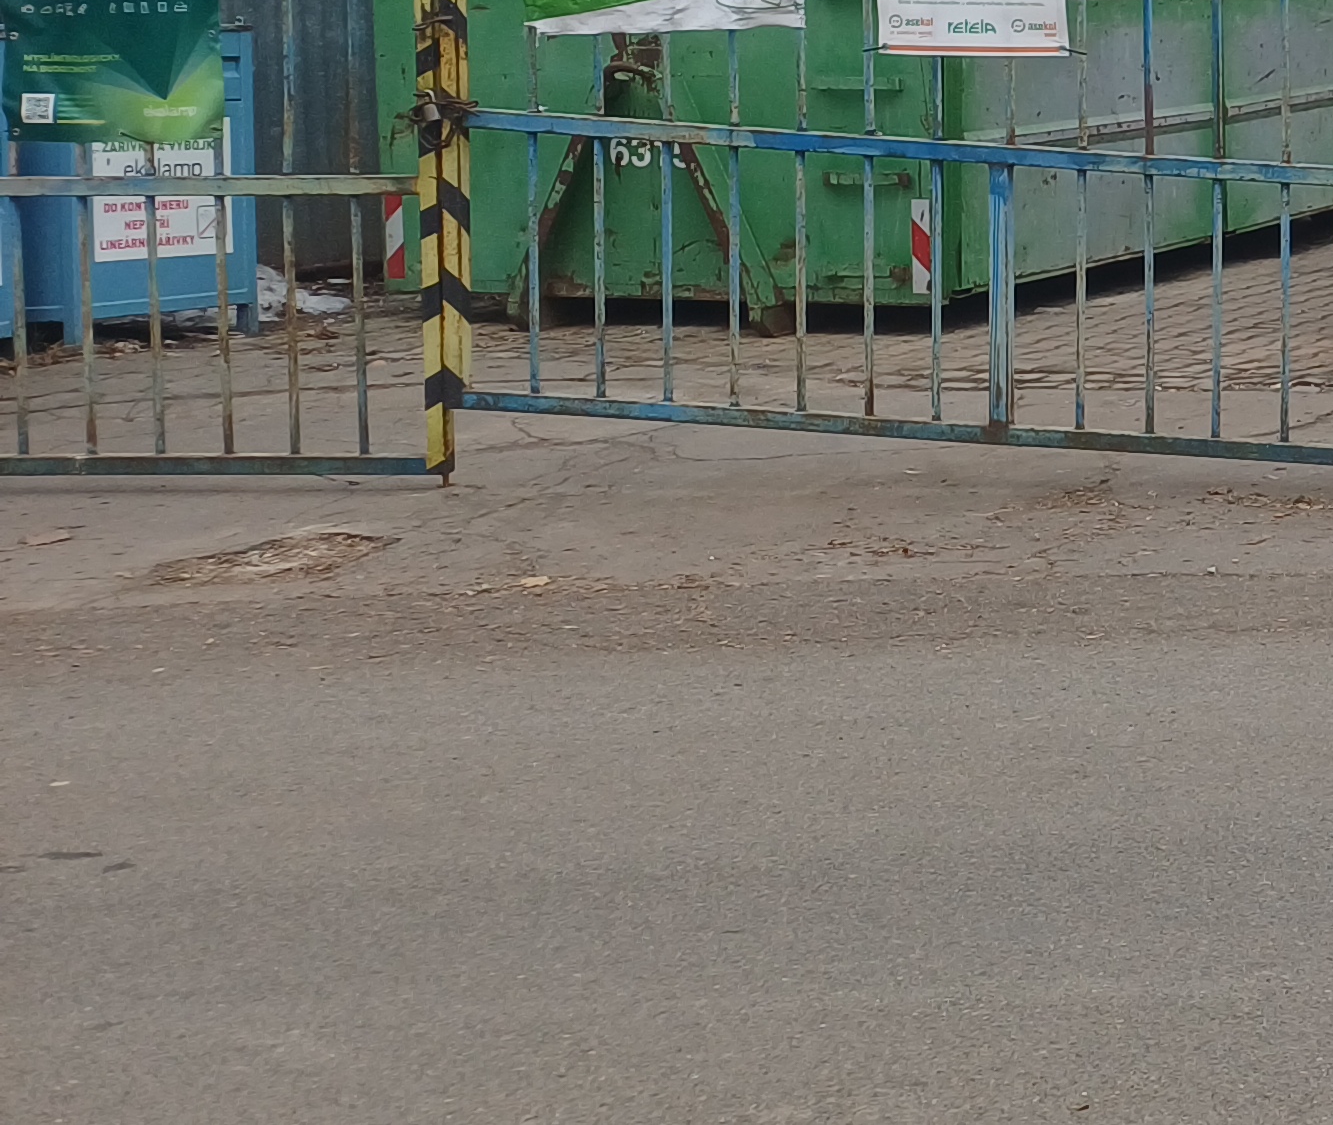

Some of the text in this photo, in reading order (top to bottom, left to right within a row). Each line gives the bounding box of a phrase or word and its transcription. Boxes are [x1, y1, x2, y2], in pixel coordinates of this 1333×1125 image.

[143, 104, 197, 118] ekolamp
[103, 202, 118, 213] DO
[100, 232, 195, 251] LINEÁRN ÁŘIVKY
